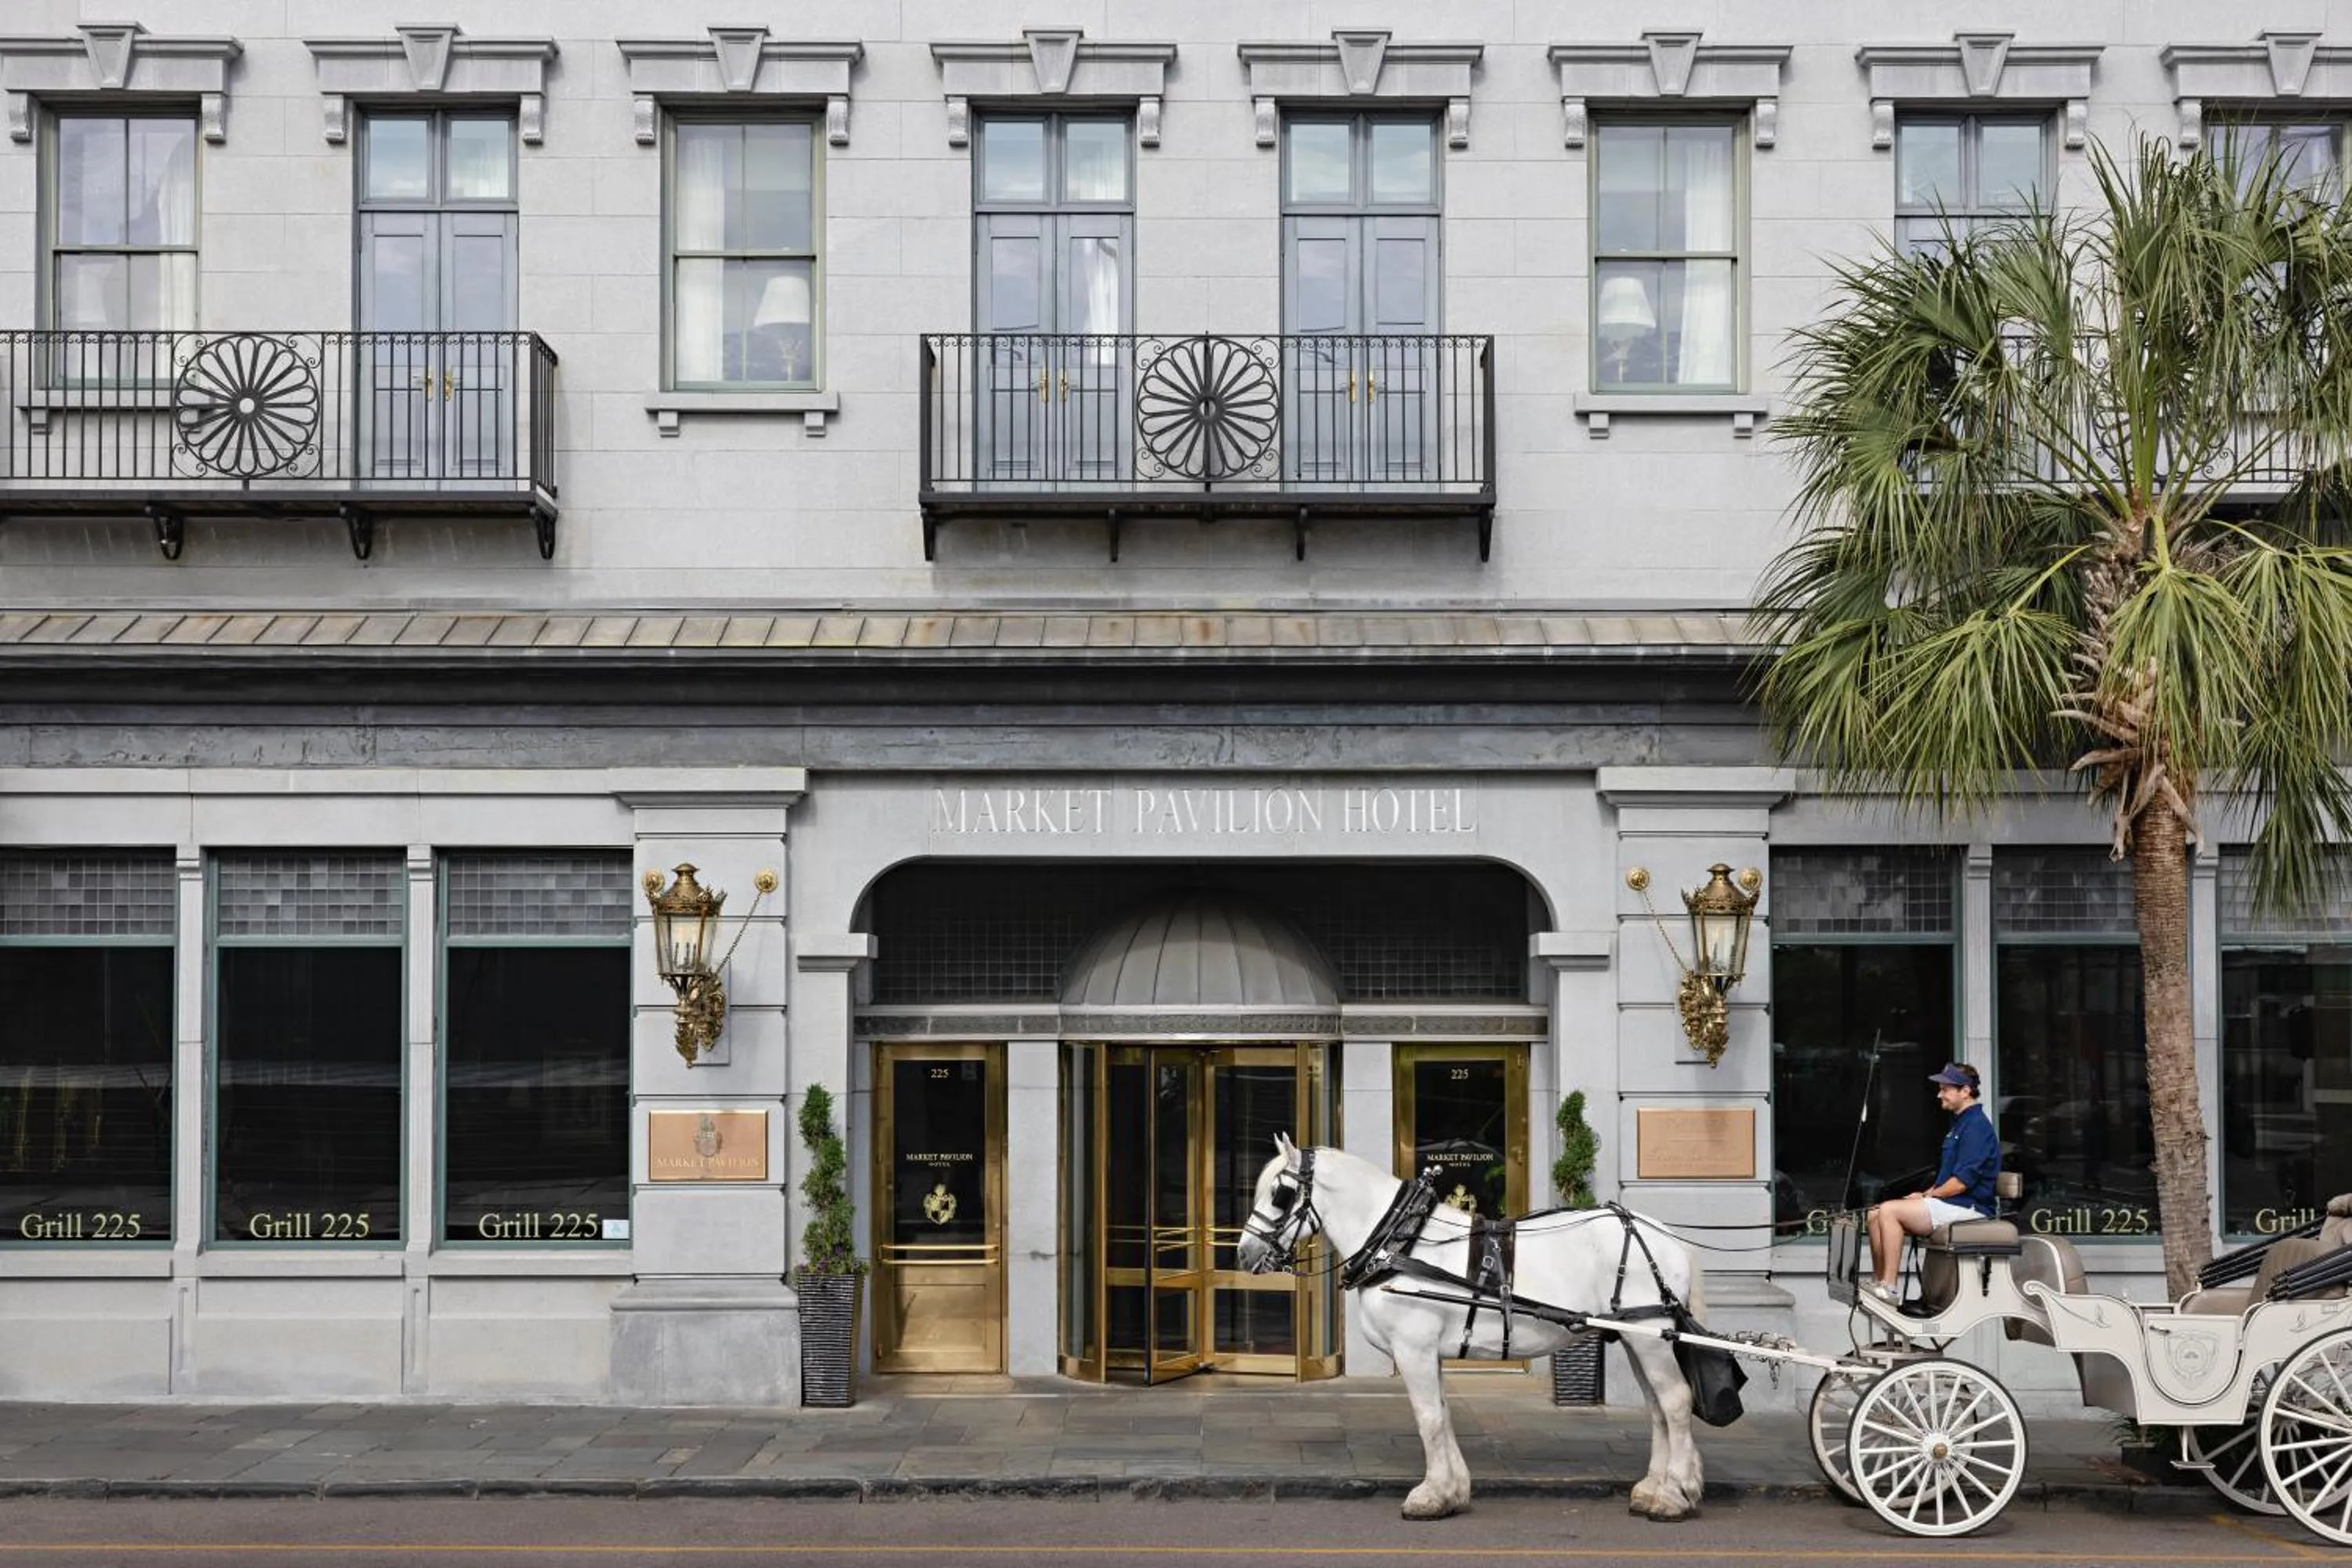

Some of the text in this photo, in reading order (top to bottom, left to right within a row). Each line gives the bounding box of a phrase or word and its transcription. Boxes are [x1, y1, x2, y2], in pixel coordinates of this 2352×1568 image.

[932, 787, 1478, 834] MARKET PAVILION HOTEL
[930, 1069, 949, 1079] 225
[1450, 1069, 1468, 1080] 225
[20, 1213, 141, 1239] Grill 225
[249, 1213, 369, 1239] Grill 225
[478, 1213, 598, 1239] Grill 225
[2030, 1207, 2150, 1233] Grill 225
